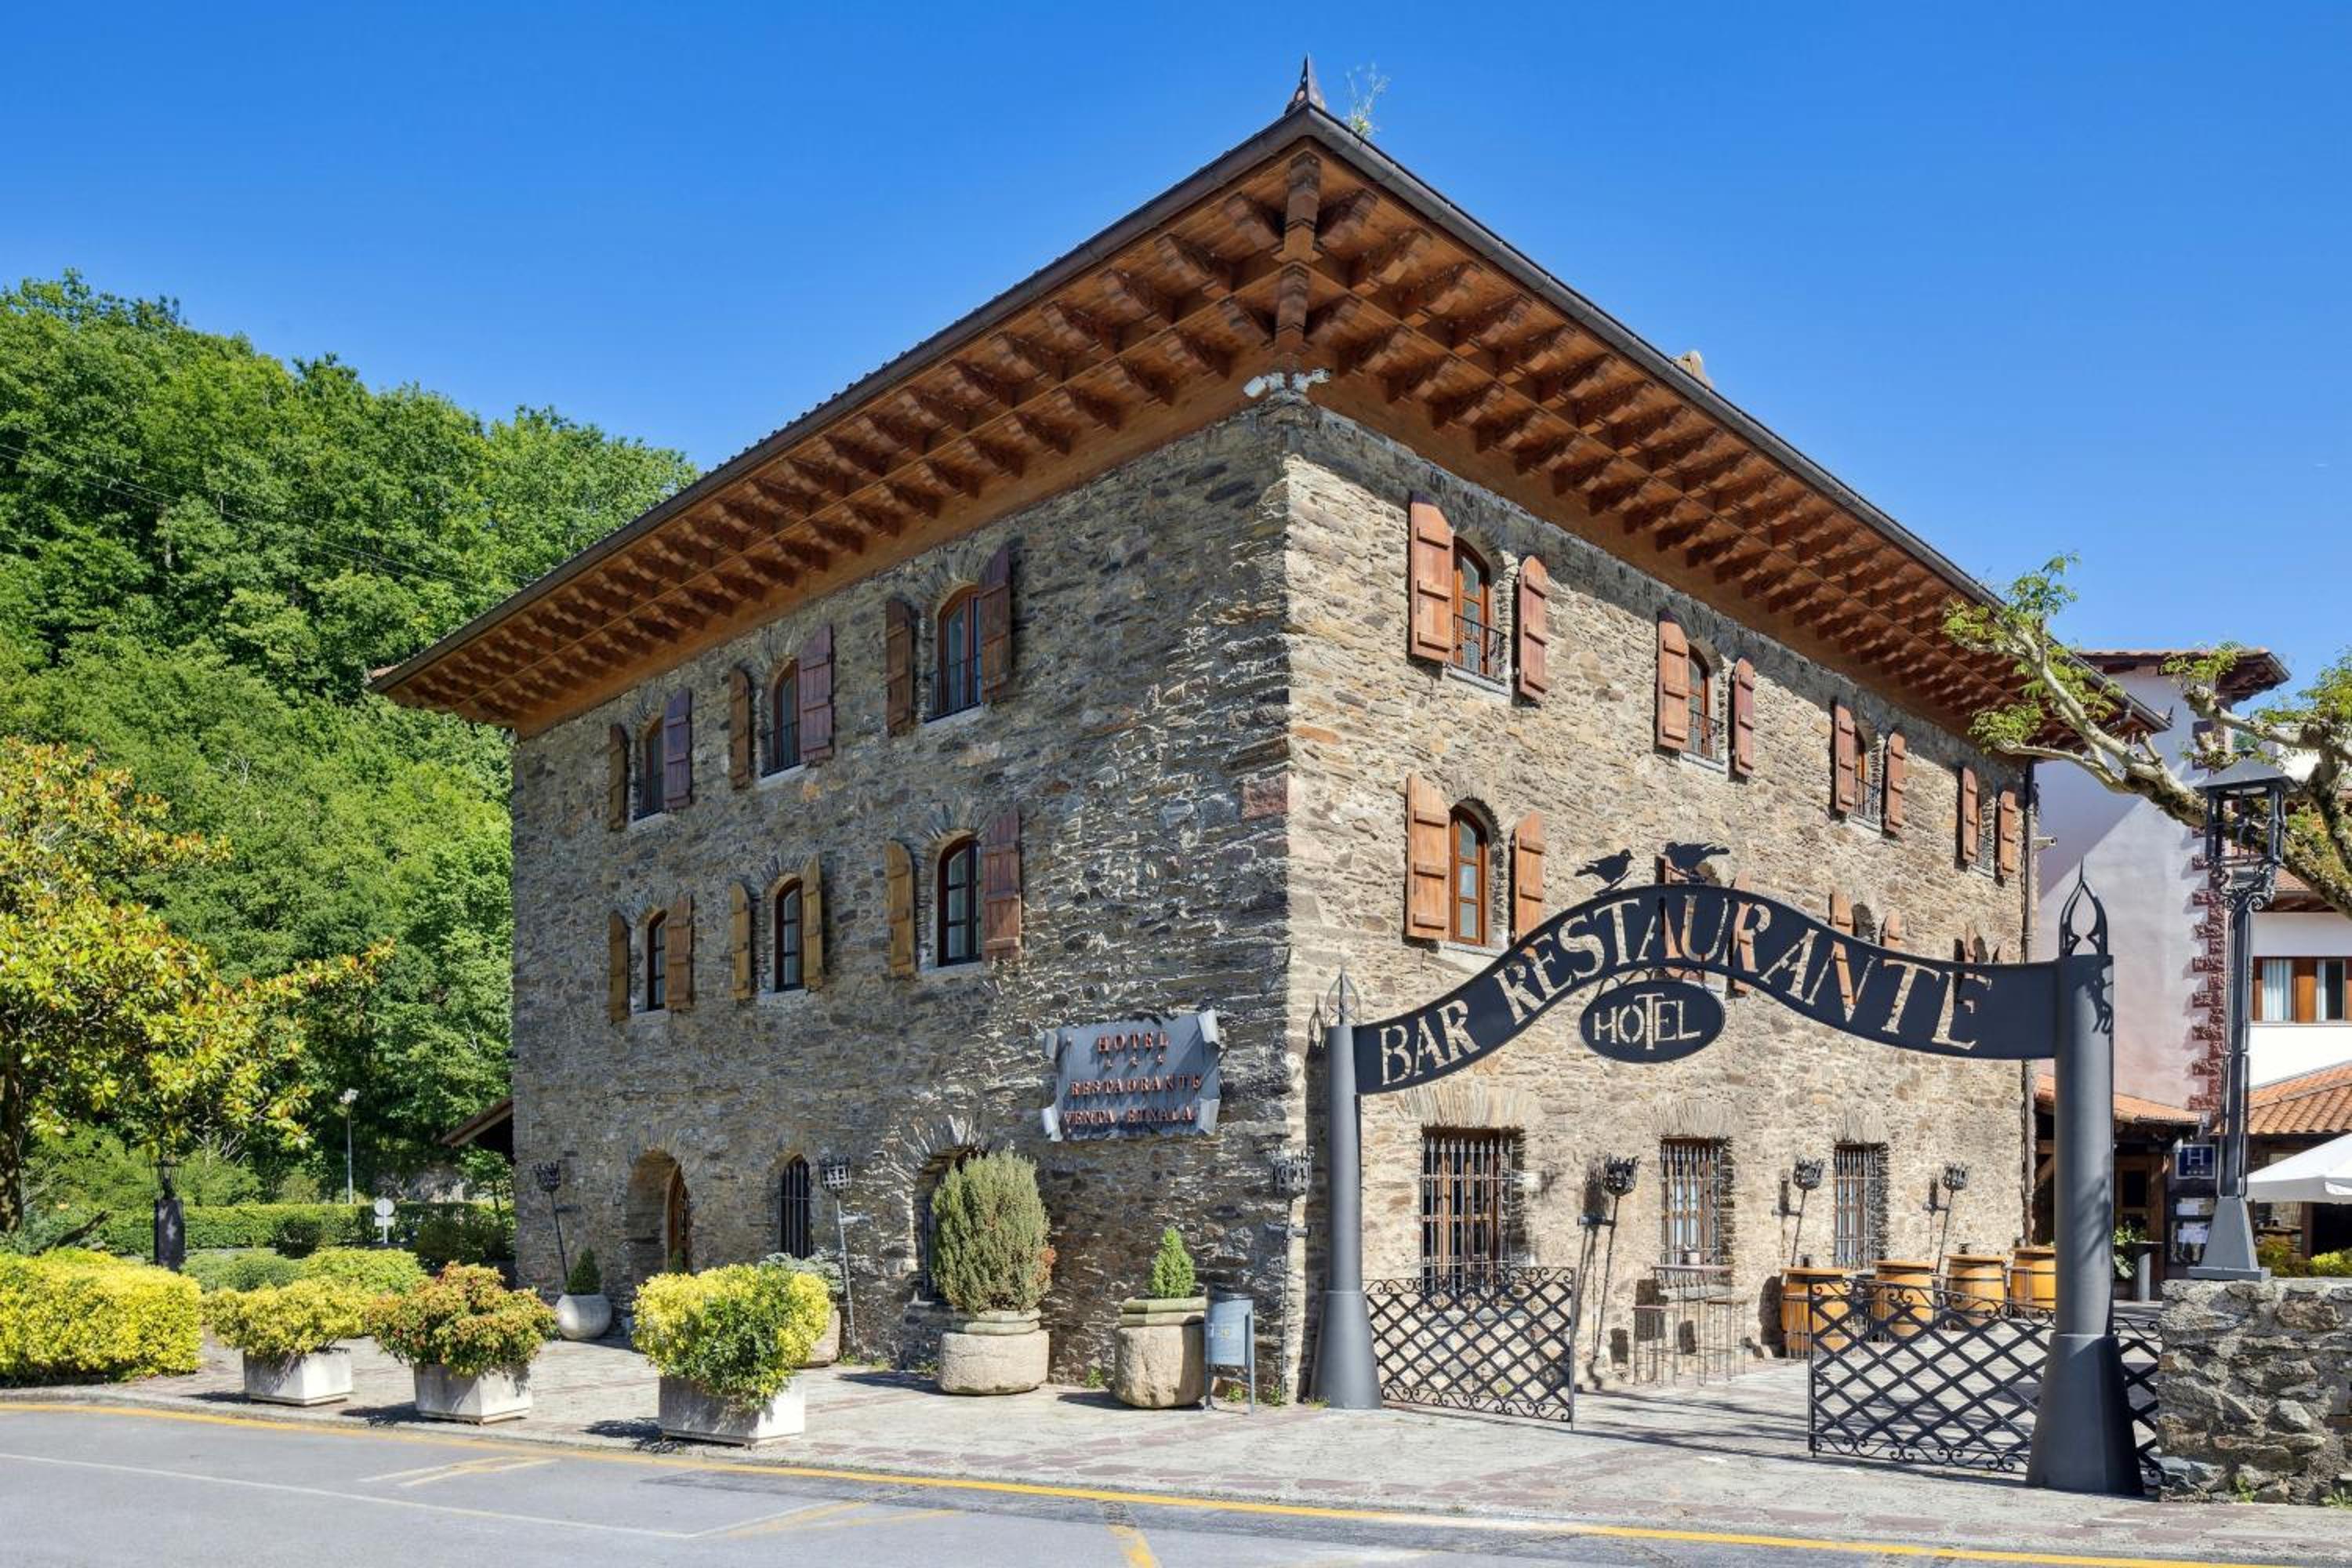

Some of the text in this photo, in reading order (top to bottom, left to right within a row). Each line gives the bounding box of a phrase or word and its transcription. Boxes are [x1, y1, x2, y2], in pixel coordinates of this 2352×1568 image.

[1379, 895, 1993, 1086] BAR RESTAURANTE
[1594, 993, 1701, 1051] HOTEL
[1098, 1030, 1169, 1053] HOTEL
[1071, 1073, 1203, 1097] RESTAURANTE
[1063, 1109, 1117, 1125] VENTA
[2187, 1149, 2205, 1167] H
